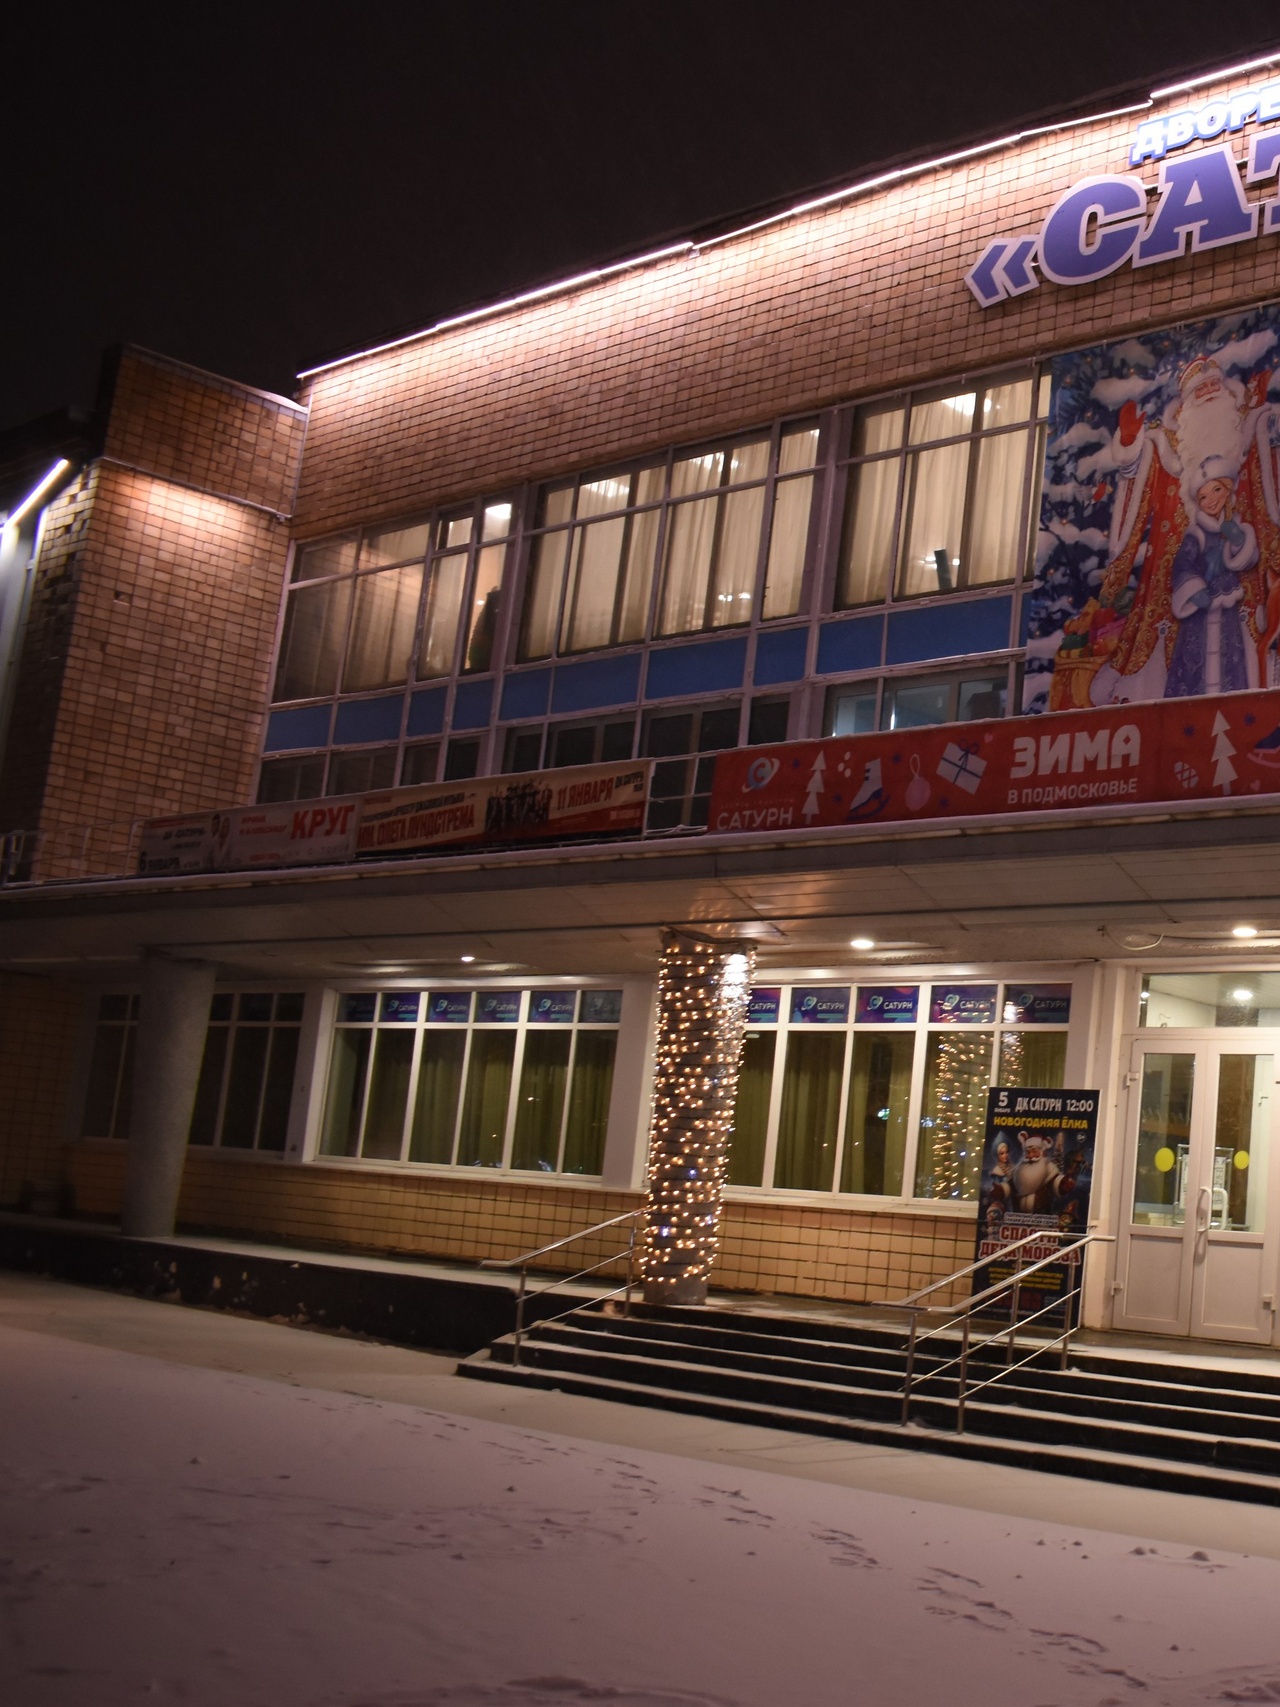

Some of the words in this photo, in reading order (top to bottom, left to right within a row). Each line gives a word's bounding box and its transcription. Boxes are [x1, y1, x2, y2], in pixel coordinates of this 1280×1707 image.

[1010, 724, 1141, 779] ЗИМА
[567, 777, 614, 809] ЯНВАРЯ
[1007, 789, 1019, 805] В
[1022, 777, 1138, 805] ПОДМОСКОВЬЕ
[290, 804, 355, 840] КРУГ
[716, 806, 794, 831] САТУРН
[750, 1002, 776, 1010] САТУРН
[816, 1002, 845, 1010] САТУРН
[883, 1001, 912, 1009] САТУРН
[960, 1000, 990, 1009] САТУРН
[1034, 1000, 1067, 1009] САТУРН
[998, 1091, 1009, 1107] 5
[1015, 1097, 1029, 1113] ДК
[1029, 1098, 1062, 1112] САТУРН
[1066, 1099, 1094, 1113] 12:00
[993, 1116, 1060, 1129] НОВОГОДНЯЯ
[1061, 1115, 1089, 1129] ЁЛКА
